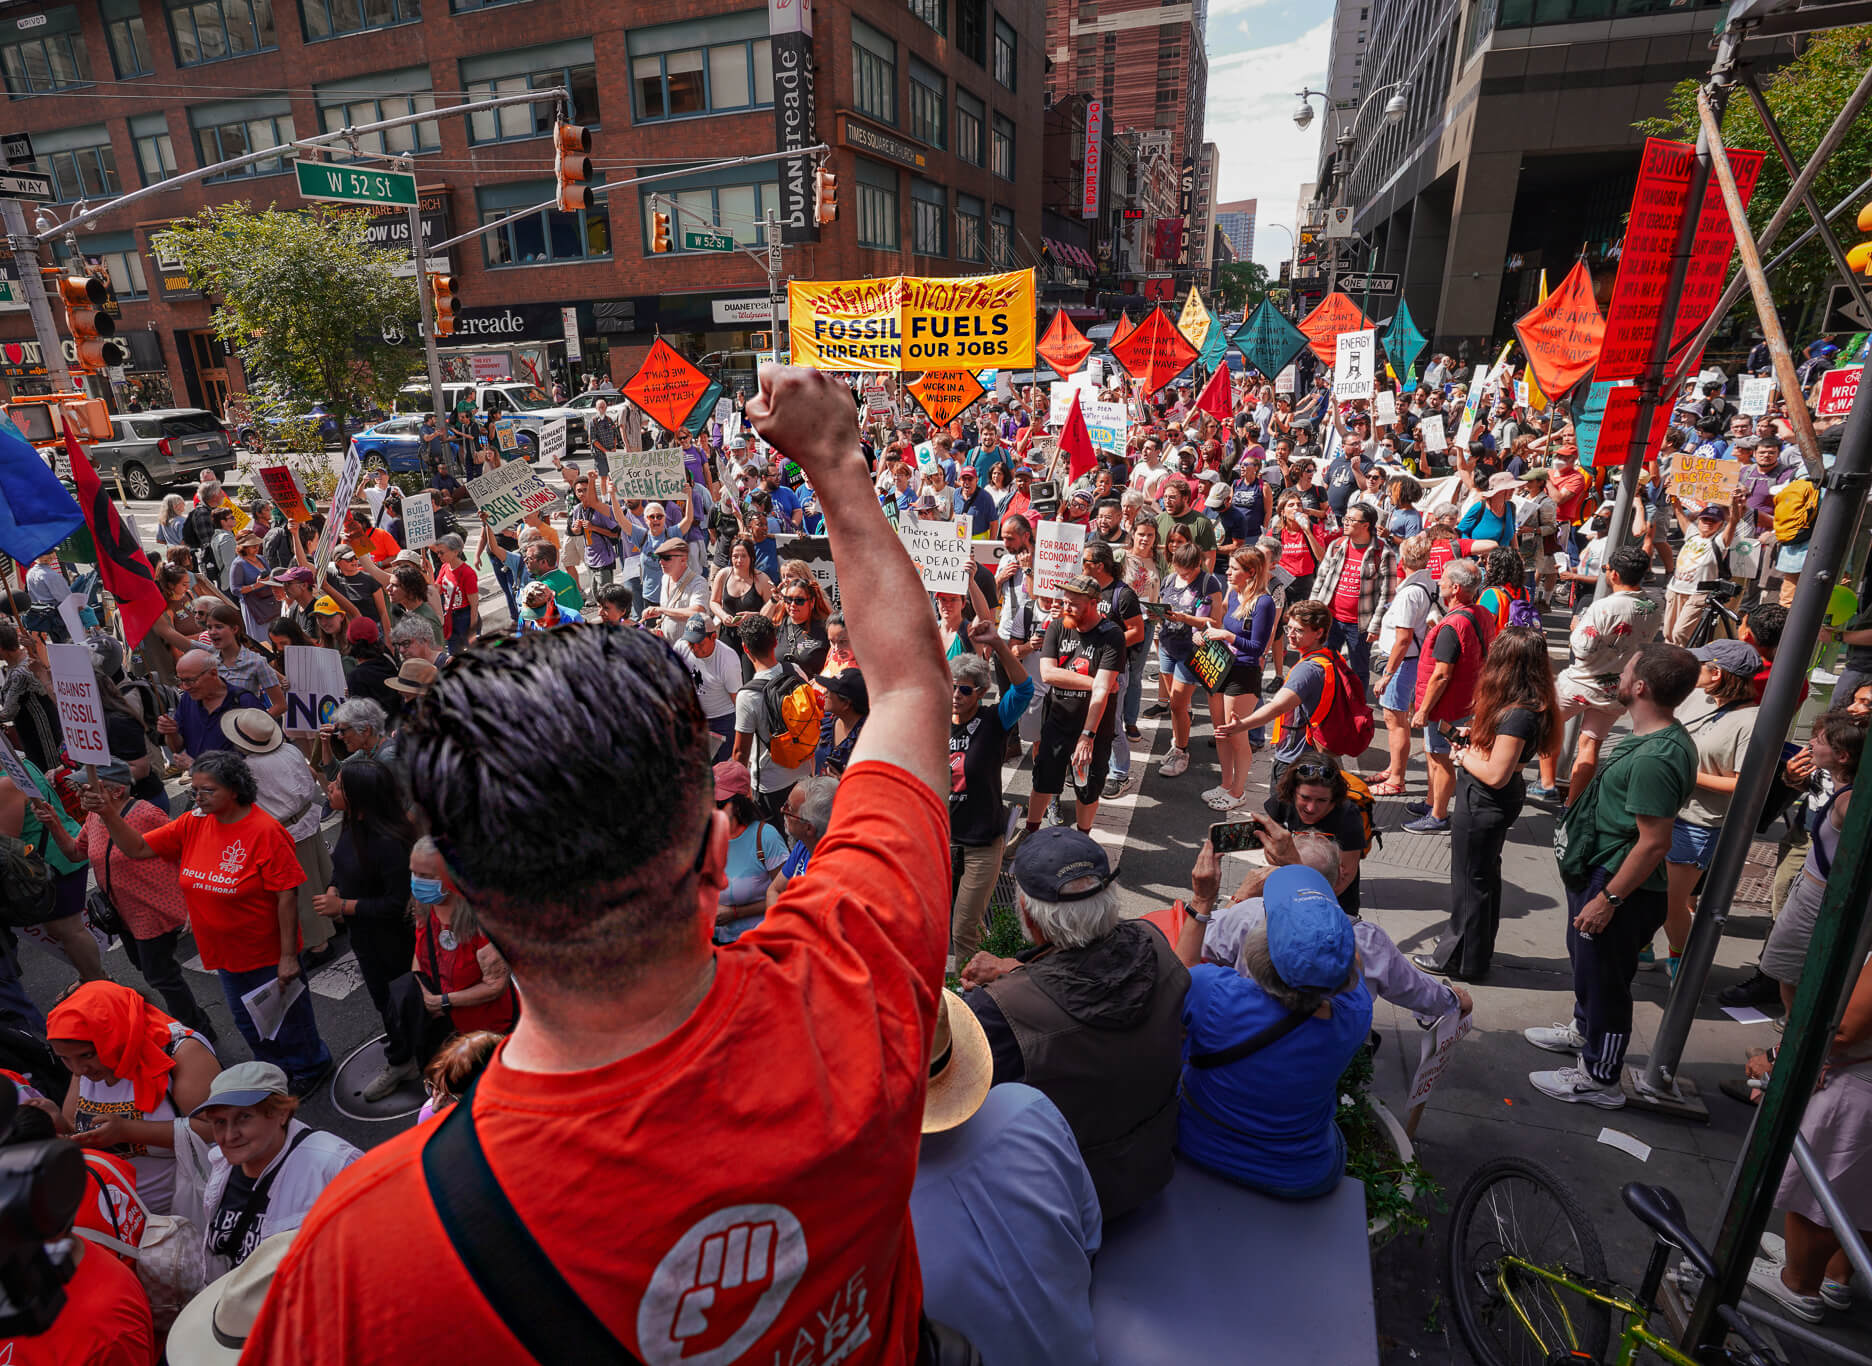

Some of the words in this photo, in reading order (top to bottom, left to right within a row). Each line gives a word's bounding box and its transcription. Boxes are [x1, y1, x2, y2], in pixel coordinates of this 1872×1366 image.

[848, 124, 867, 145] TIMES
[8, 143, 25, 156] WAY
[1086, 103, 1100, 205] GALLAGHERS
[16, 180, 43, 192] WAY
[327, 171, 342, 193] W
[351, 174, 370, 196] 52
[376, 177, 392, 198] St
[1344, 279, 1362, 288] ONE
[1370, 280, 1390, 289] WAY
[814, 318, 901, 340] FOSSIL
[912, 314, 1008, 338] FUELS
[816, 344, 901, 358] THREATEN
[909, 342, 949, 358] OUR
[956, 340, 1008, 356] JOBS
[1340, 336, 1371, 350] ENERGY
[1152, 360, 1178, 370] WAVE
[958, 384, 965, 392] A
[1336, 381, 1371, 395] EFFICIENT
[1832, 385, 1858, 398] WRO
[1837, 398, 1854, 410] WA
[540, 424, 566, 442] HUMANITY
[1090, 428, 1109, 441] IKEA
[544, 434, 564, 448] NATURE
[615, 449, 680, 468] TEACHERS
[466, 460, 532, 500] TEACHERS
[626, 468, 640, 478] for
[645, 469, 652, 478] a
[614, 478, 656, 497] GREEN
[480, 494, 524, 527] GREEN
[514, 475, 546, 498] JOBS
[406, 505, 430, 516] BUILD
[408, 518, 432, 528] FOSSIL
[408, 525, 433, 538] FREE
[901, 526, 928, 536] There
[912, 538, 930, 551] NO
[934, 540, 966, 552] BEER
[1040, 540, 1053, 550] FOR
[926, 556, 960, 567] DEAD
[1039, 550, 1078, 564] ECONOMIC
[923, 570, 967, 583] PLANET
[1190, 657, 1216, 688] FUELS
[1195, 650, 1220, 681] FOSSIL
[57, 682, 92, 698] AGAINST
[60, 702, 98, 724] FOSSIL
[68, 727, 104, 751] FUELS
[182, 868, 206, 880] new
[208, 872, 239, 886] labor
